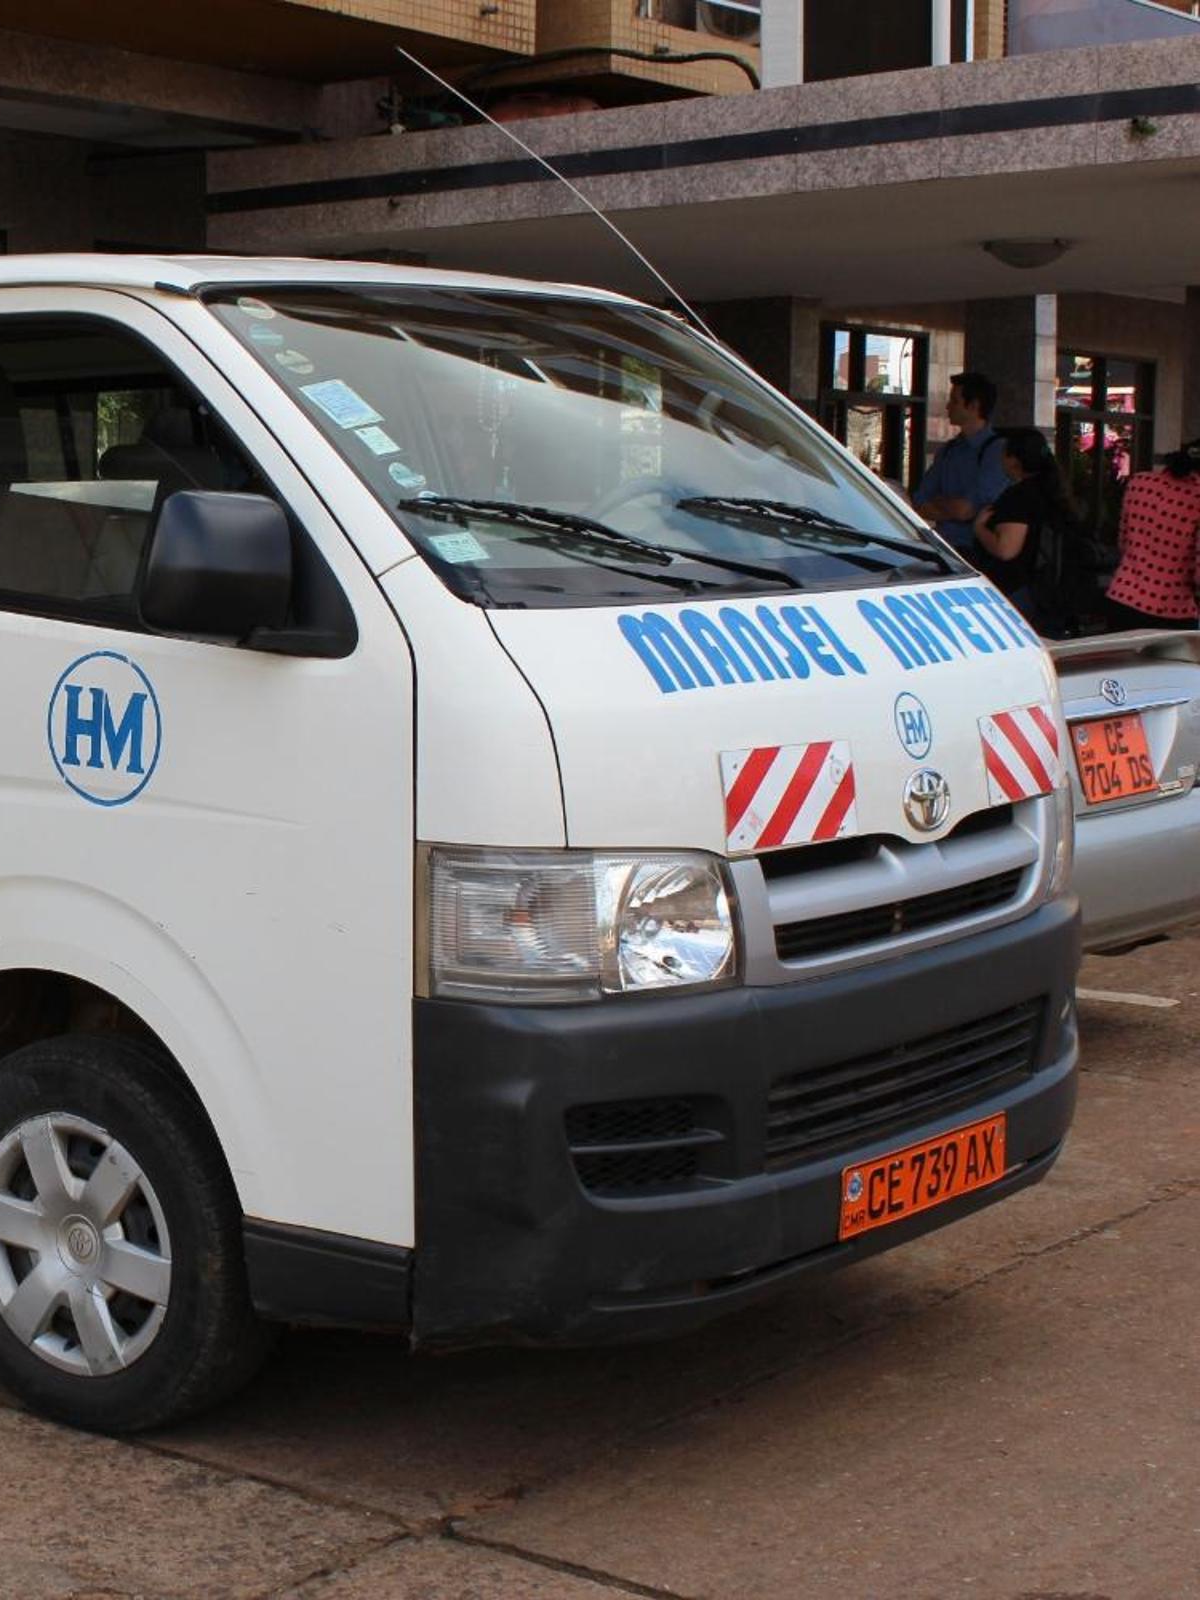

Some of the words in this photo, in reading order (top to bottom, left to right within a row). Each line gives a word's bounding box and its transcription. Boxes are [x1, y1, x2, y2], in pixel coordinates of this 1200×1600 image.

[617, 604, 867, 694] MANSEL
[62, 684, 148, 774] HM
[899, 710, 928, 744] HM
[1103, 721, 1129, 756] CE
[1085, 761, 1121, 797] 704
[1127, 754, 1153, 789] DS
[867, 1159, 904, 1220] CE
[910, 1142, 957, 1205] 739
[964, 1126, 996, 1185] AX
